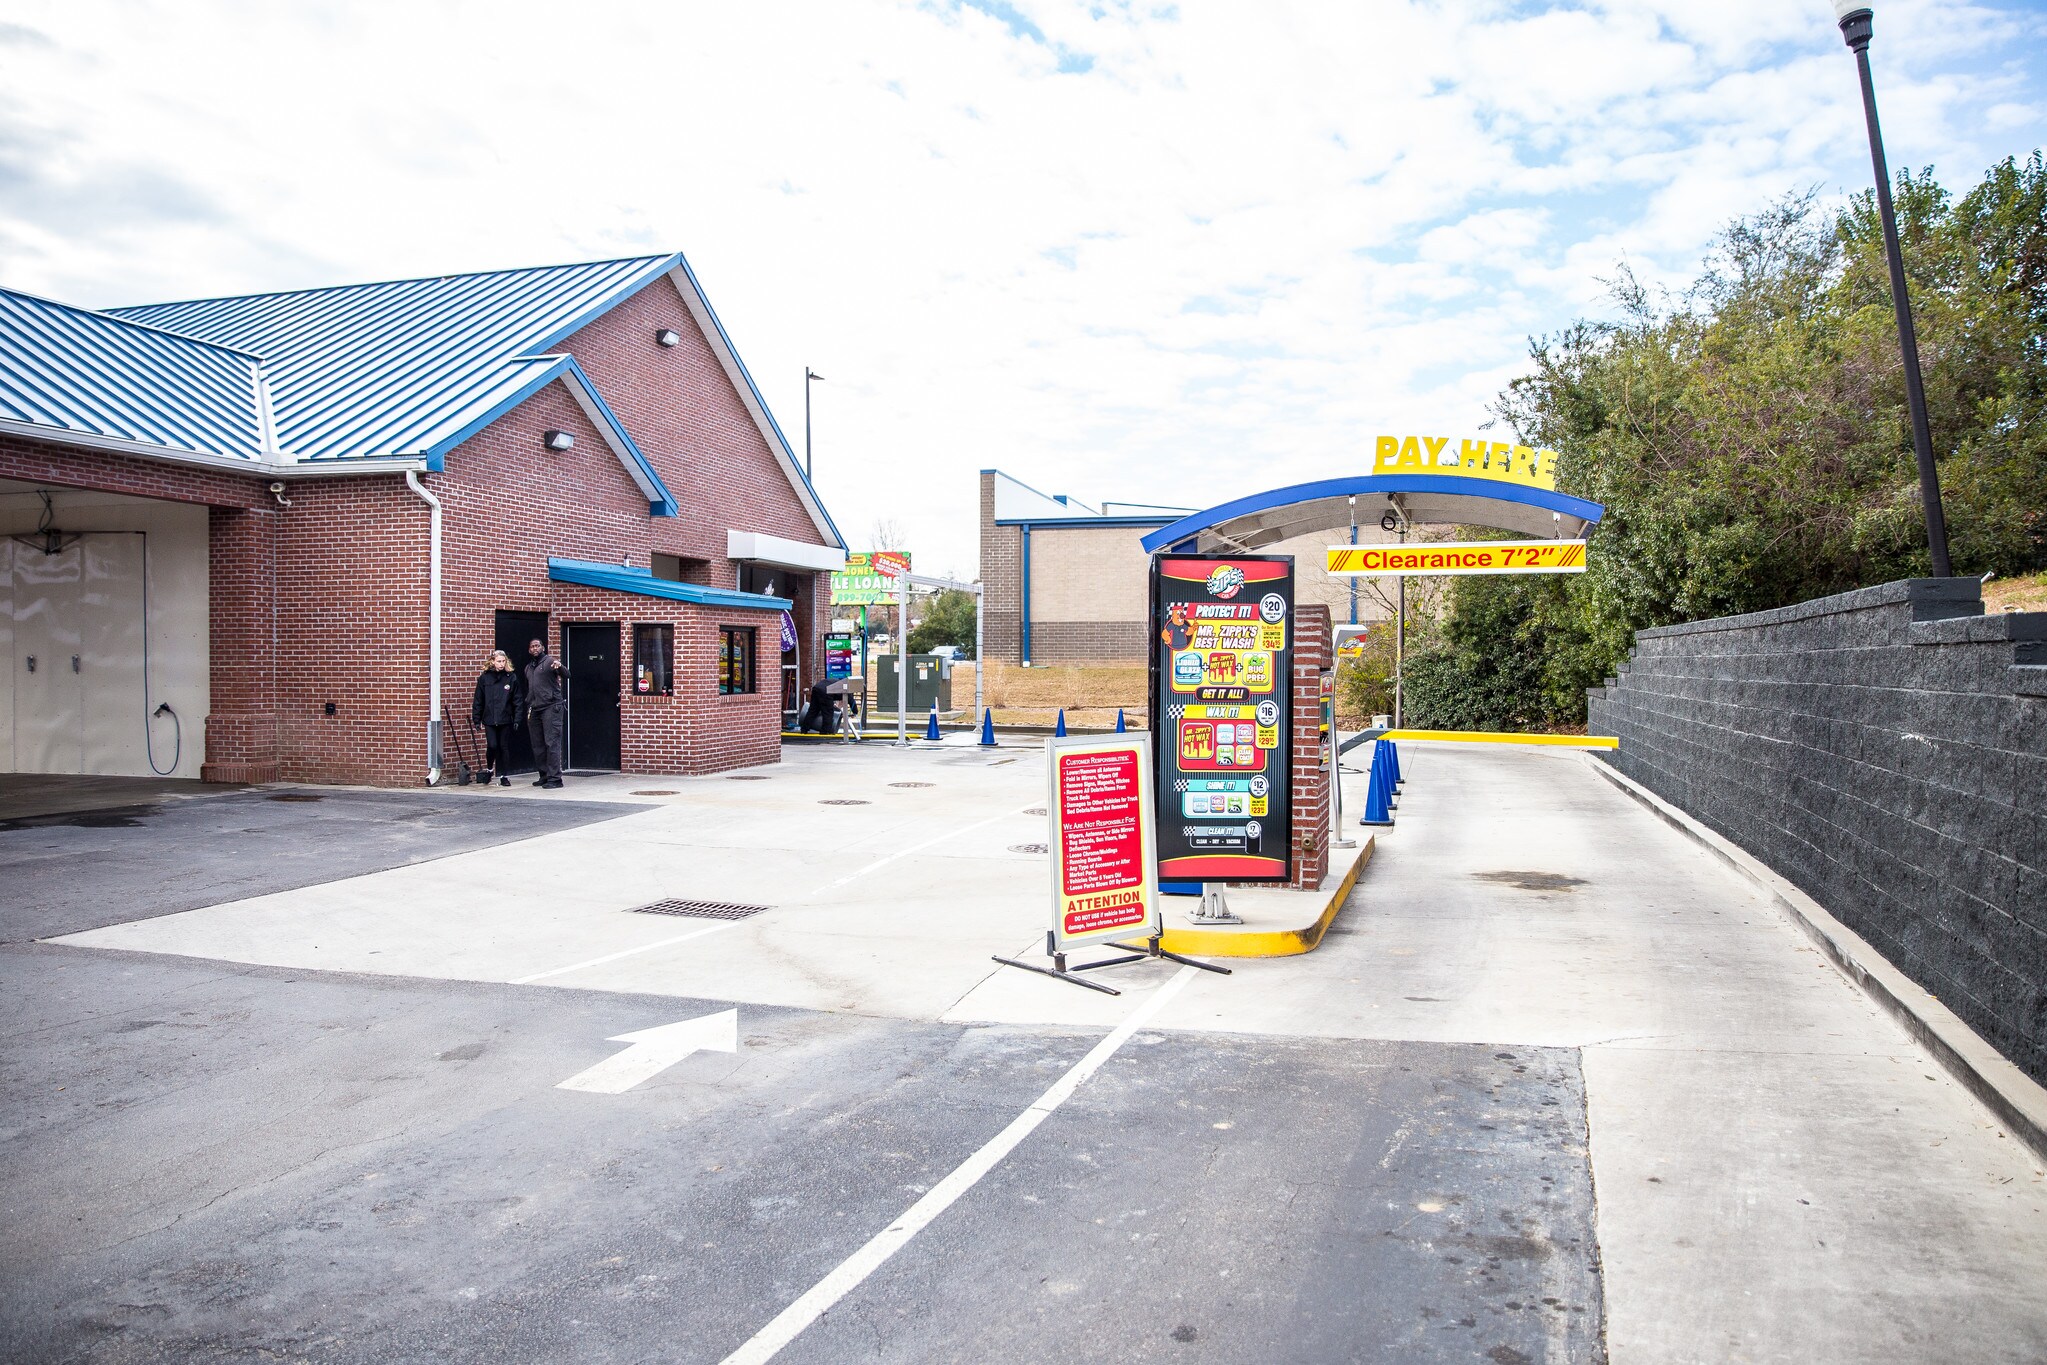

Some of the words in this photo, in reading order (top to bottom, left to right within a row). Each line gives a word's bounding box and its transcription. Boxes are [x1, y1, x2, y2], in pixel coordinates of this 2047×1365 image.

[1375, 435, 1449, 467] PAY
[1458, 439, 1559, 480] HERE
[1362, 551, 1493, 569] Clearance
[843, 566, 875, 576] MONEY
[854, 576, 900, 590] LOANS
[1212, 571, 1238, 592] ZIPS
[1195, 604, 1237, 618] PROTECT
[1238, 605, 1252, 618] IT!
[1265, 600, 1280, 612] $20
[1197, 625, 1215, 637] MR.
[1219, 625, 1258, 637] ZIPPY'S
[1194, 637, 1219, 649] BEST
[1222, 637, 1255, 649] WASH!
[1247, 665, 1264, 674] BUG
[1246, 674, 1266, 682] PREP
[1202, 689, 1216, 698] GET
[1217, 689, 1225, 698] IT
[1227, 689, 1244, 698] ALL!
[1206, 706, 1227, 718] WAX
[1227, 706, 1240, 718] IT!
[1261, 706, 1273, 717] $16
[1184, 734, 1195, 743] HOT
[1196, 733, 1210, 741] WAX
[1253, 780, 1264, 789] $12
[1067, 891, 1140, 912] ATTENTION
